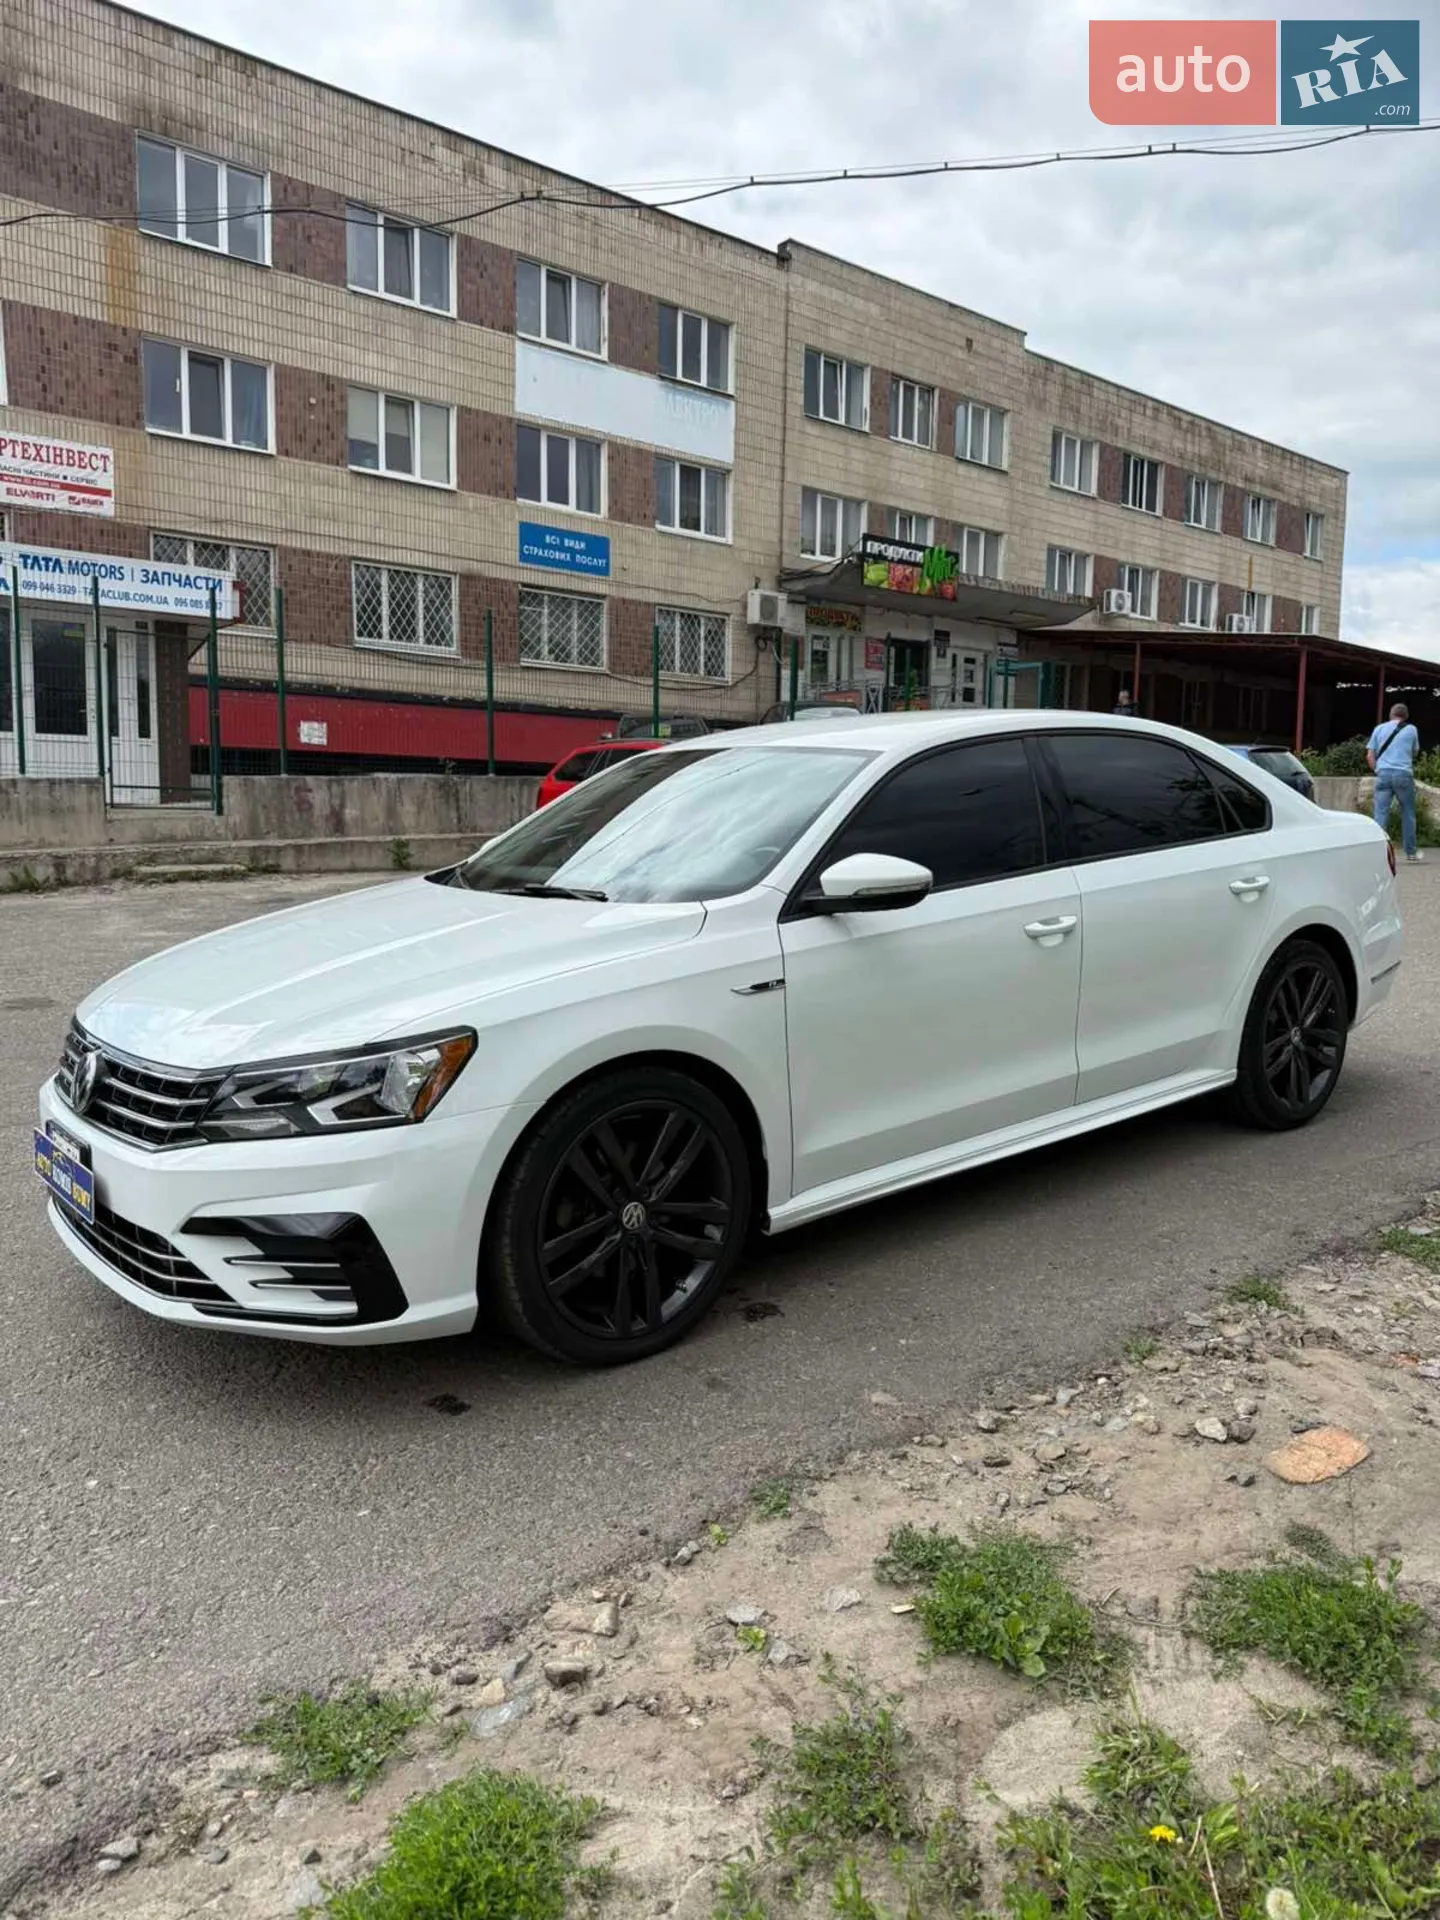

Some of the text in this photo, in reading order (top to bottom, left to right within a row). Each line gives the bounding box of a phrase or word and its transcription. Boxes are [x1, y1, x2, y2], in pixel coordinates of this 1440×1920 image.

[564, 538, 586, 550] ВИДИ
[523, 545, 606, 567] СТРАХОВИХ ПОСЛУГ
[19, 553, 222, 592] TATA MOTORS ЗАПЧАСТИ
[82, 586, 169, 606] TAACLUB.COM.UA
